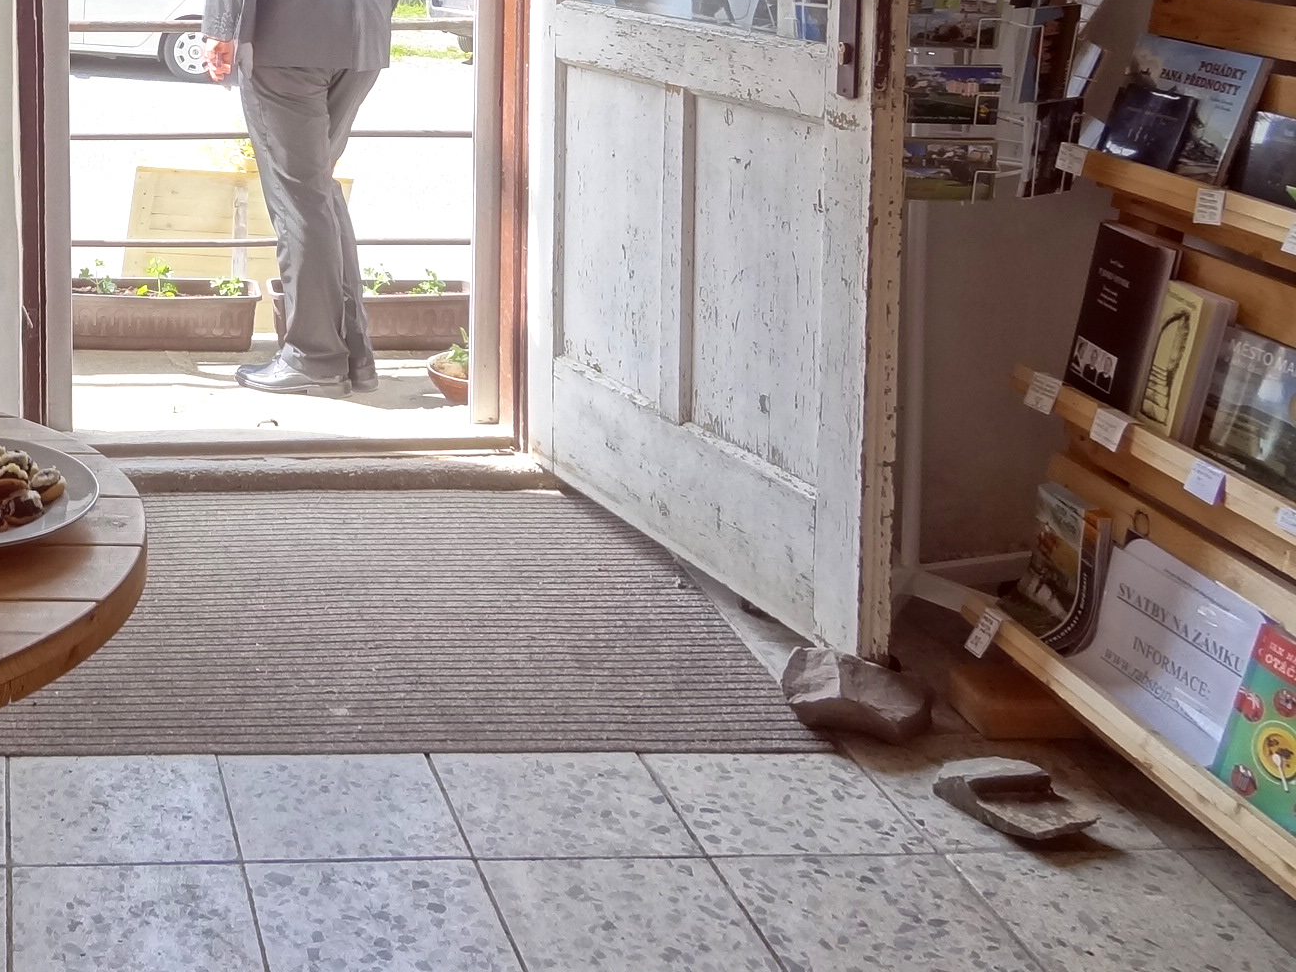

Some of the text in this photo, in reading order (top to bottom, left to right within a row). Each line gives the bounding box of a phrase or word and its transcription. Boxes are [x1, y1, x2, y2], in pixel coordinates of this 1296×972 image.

[1160, 68, 1241, 96] PANA PŘEDNOSTY
[1198, 60, 1247, 81] POHÁDKY
[1119, 582, 1171, 623] SVATBY
[1173, 614, 1189, 639] NA
[1192, 632, 1245, 673] ZÁMKU
[1133, 636, 1212, 700] INFORMACE:
